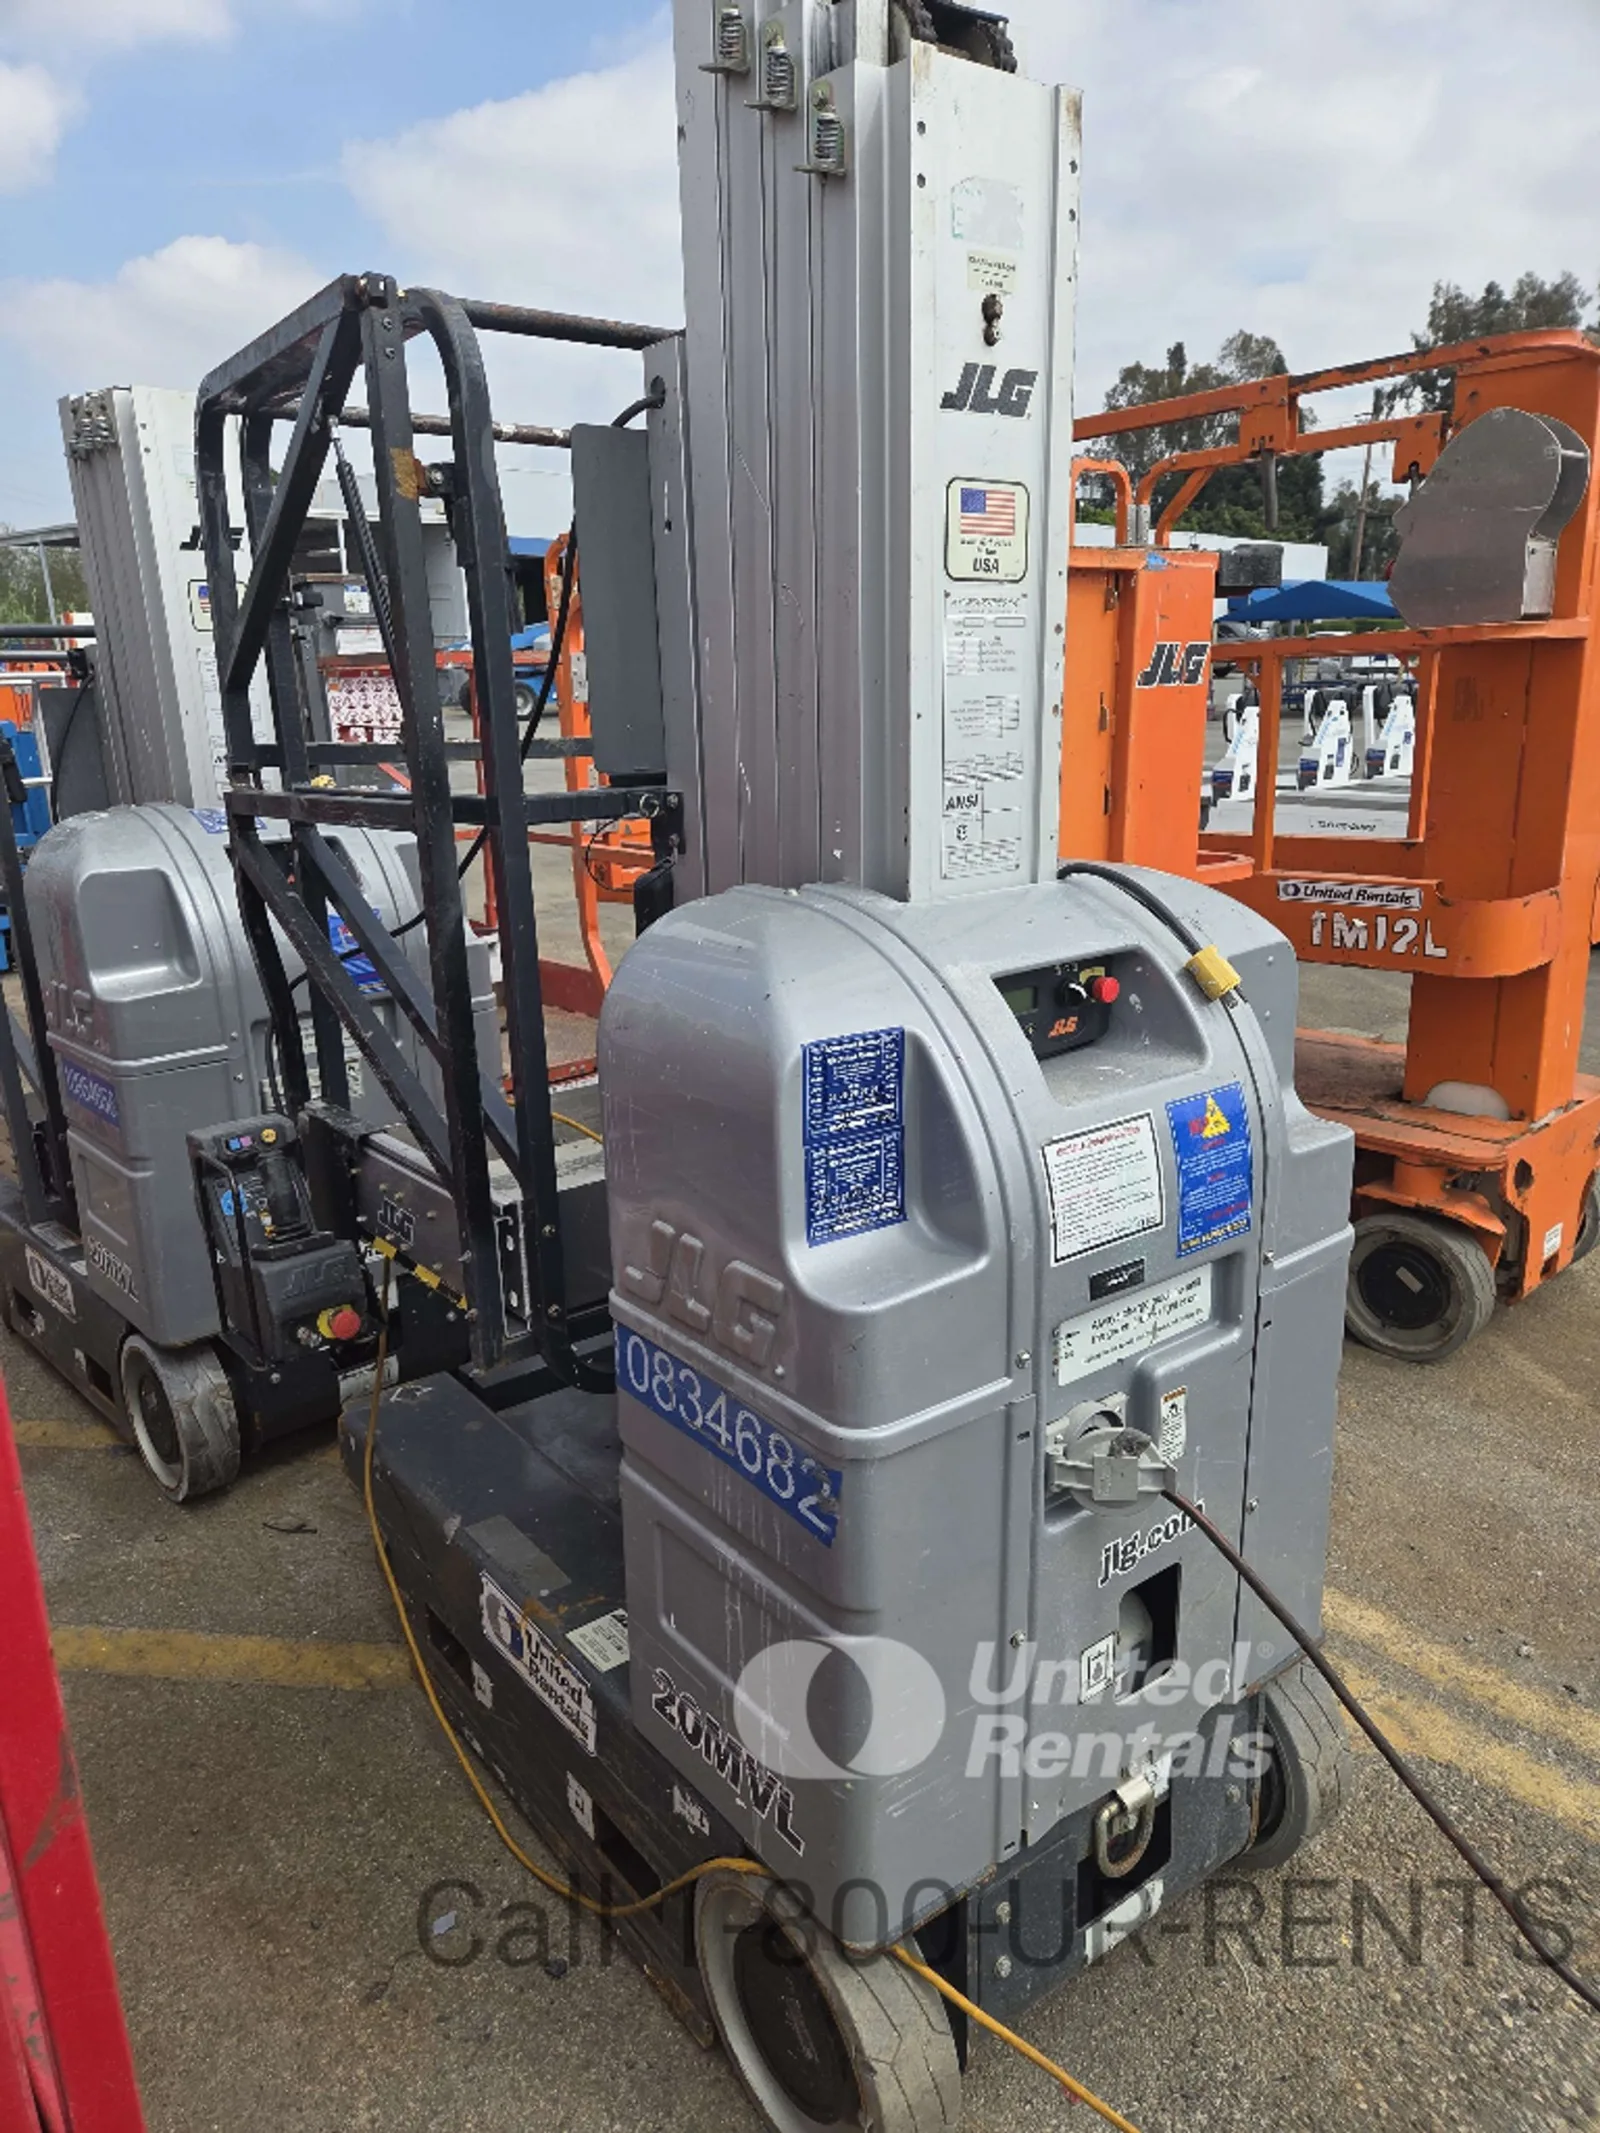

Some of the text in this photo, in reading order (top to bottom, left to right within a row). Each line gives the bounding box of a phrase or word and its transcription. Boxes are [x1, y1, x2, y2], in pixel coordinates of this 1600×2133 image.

[939, 362, 1038, 417] JLG
[972, 557, 999, 573] USA
[1136, 641, 1211, 688] JLG
[1303, 884, 1417, 905] United Rentals
[1310, 909, 1449, 959] TM12L
[377, 1195, 417, 1247] JLG
[624, 1219, 785, 1368] JLG
[524, 1628, 584, 1708] United
